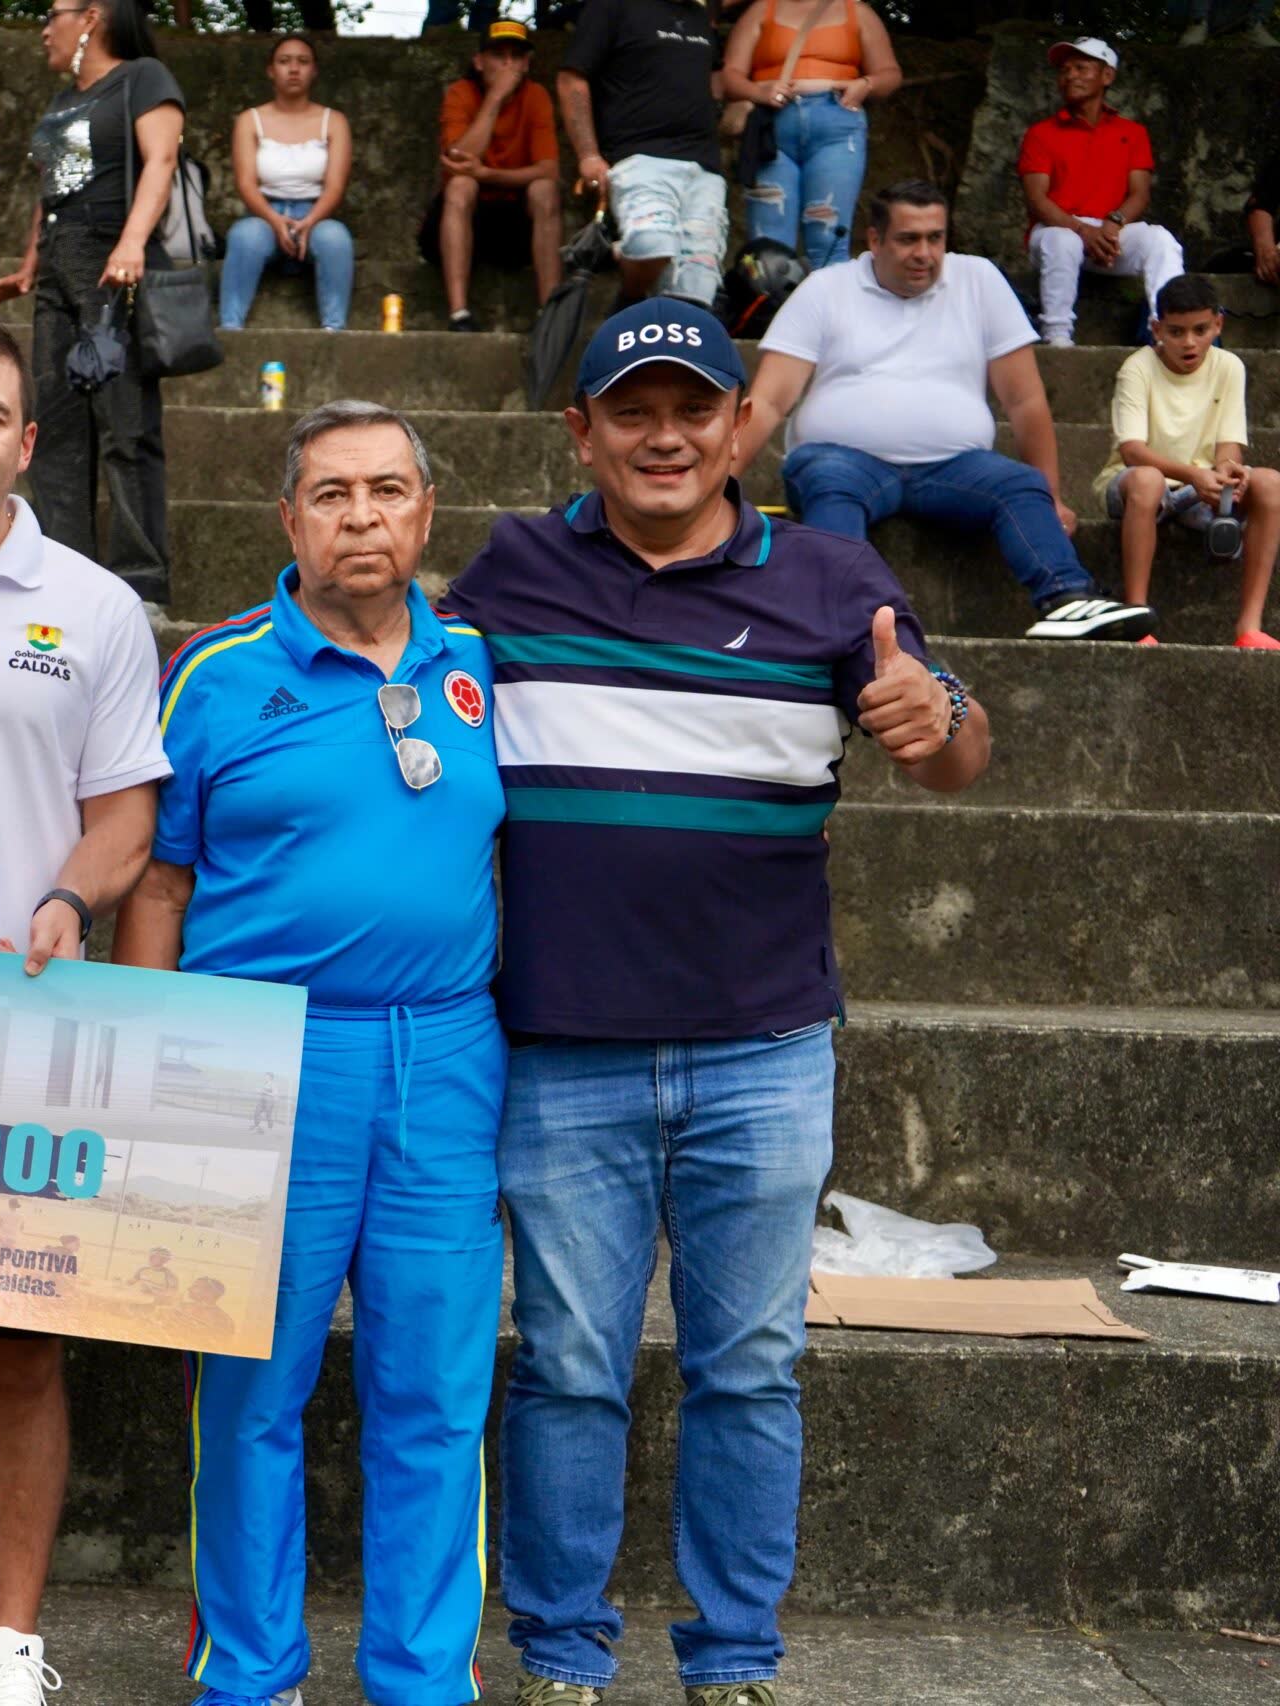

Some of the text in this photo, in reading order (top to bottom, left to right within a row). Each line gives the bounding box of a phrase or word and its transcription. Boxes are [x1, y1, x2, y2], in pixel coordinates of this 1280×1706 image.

[617, 323, 703, 352] BOSS
[14, 650, 67, 666] Gobierno de
[8, 658, 71, 681] CALDAS
[259, 703, 309, 720] adidas
